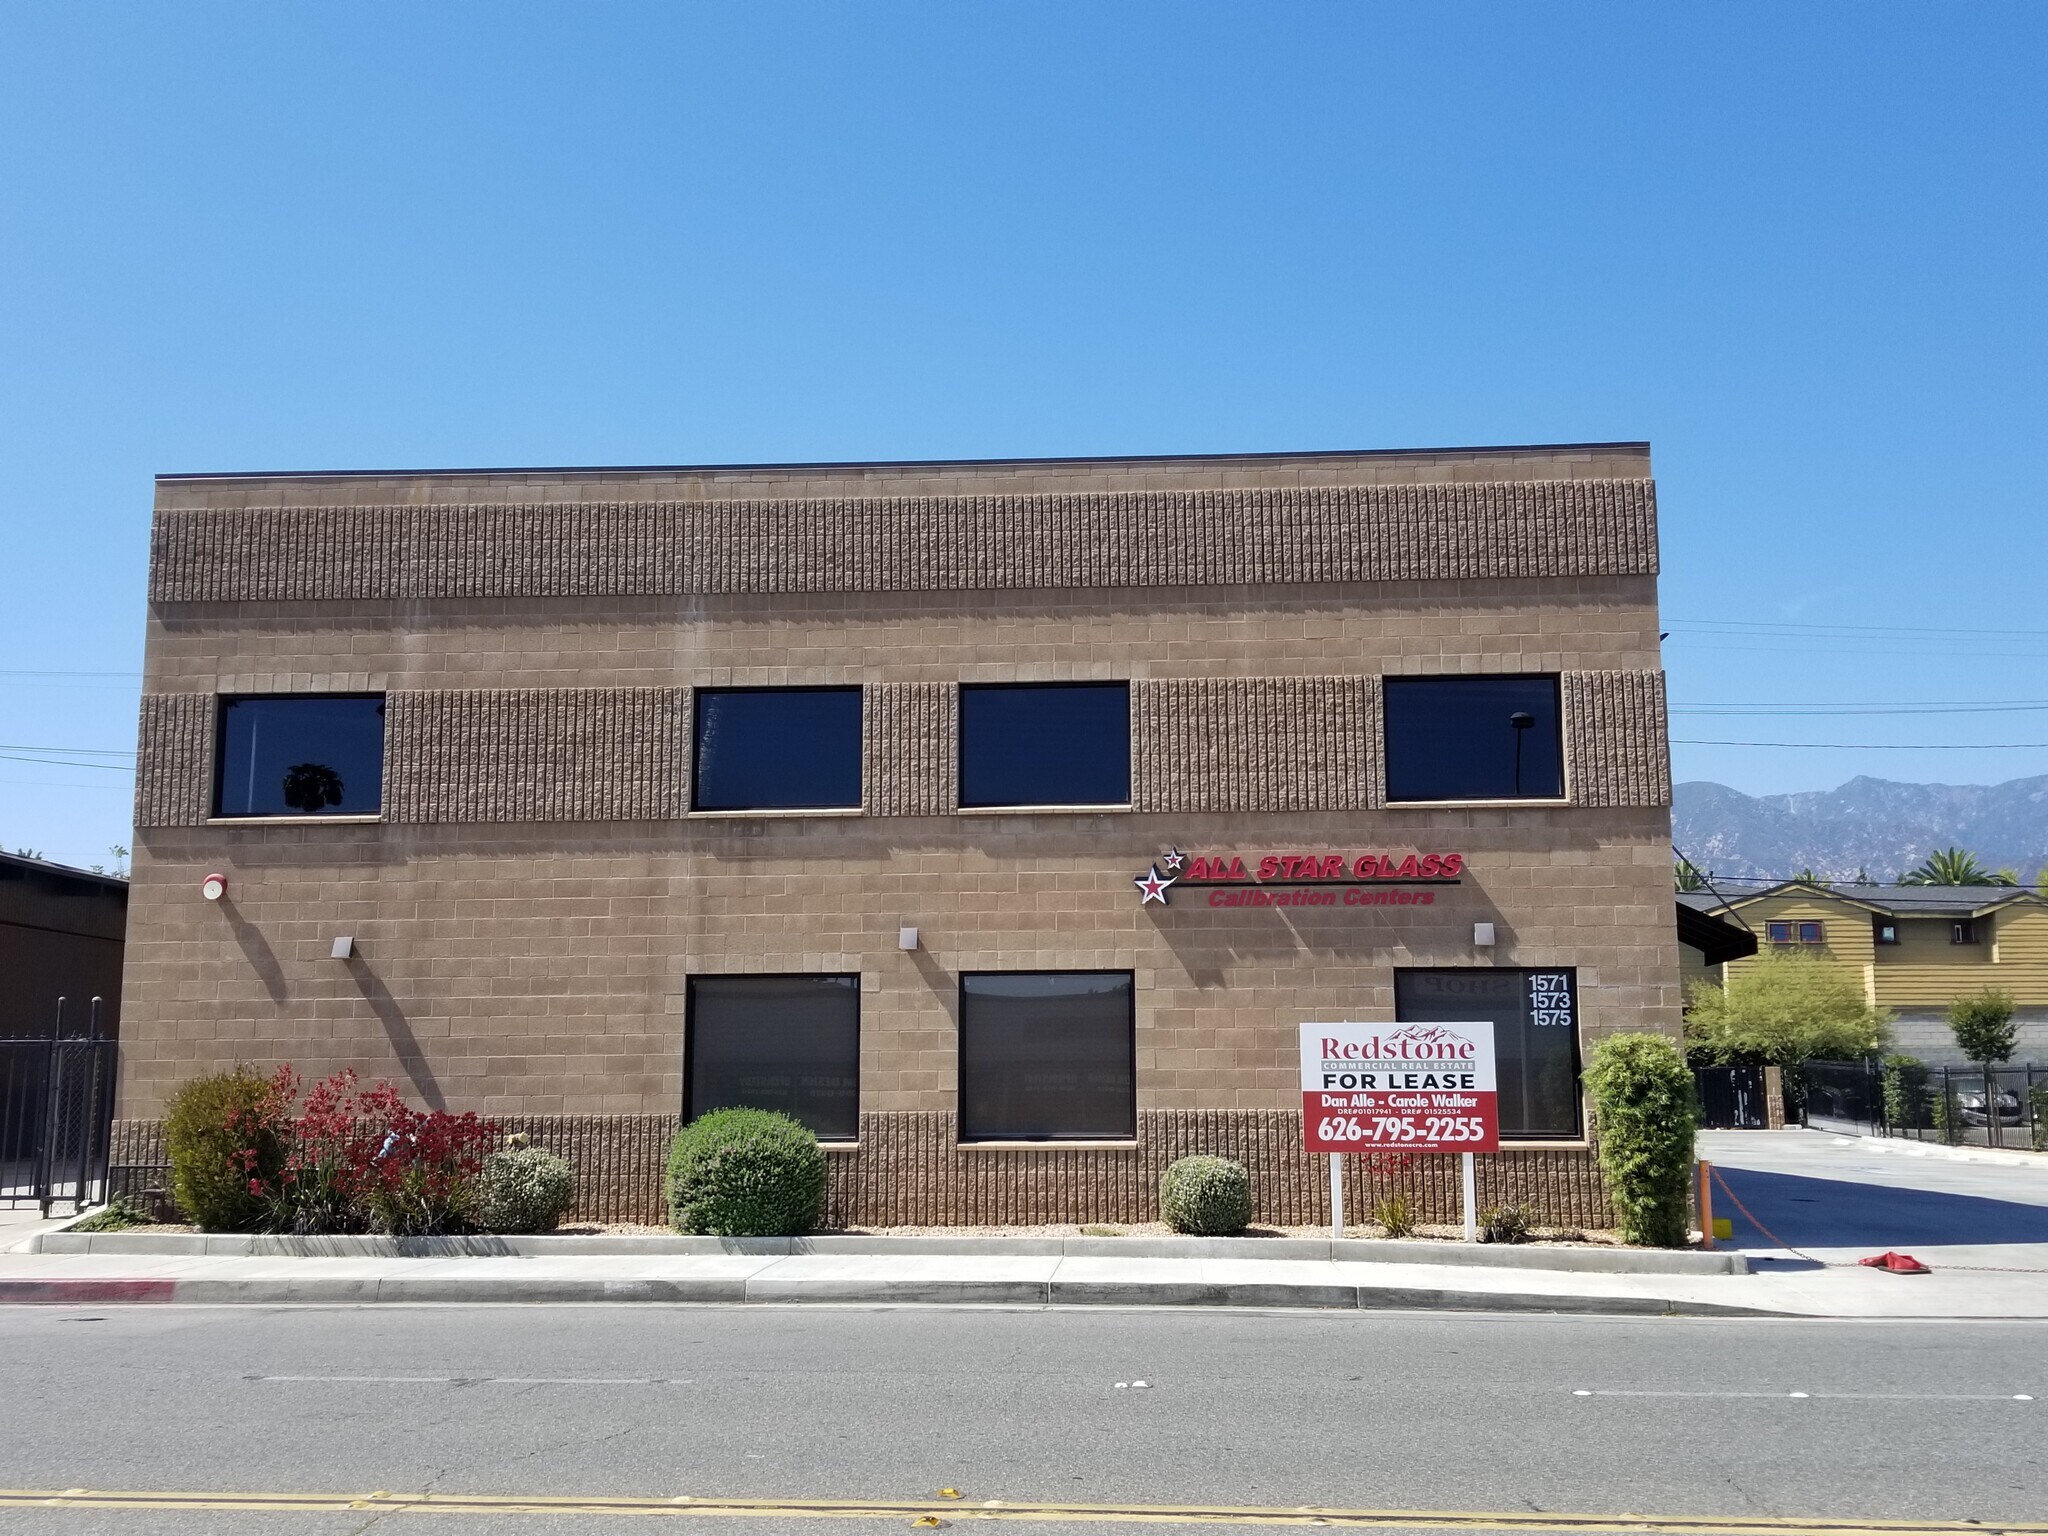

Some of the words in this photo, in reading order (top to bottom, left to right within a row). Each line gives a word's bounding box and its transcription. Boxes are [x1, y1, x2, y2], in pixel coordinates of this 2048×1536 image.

[1183, 856, 1247, 879] ALL
[1256, 855, 1344, 879] STAR
[1352, 853, 1463, 878] GLASS
[1208, 889, 1336, 907] Calibration
[1343, 888, 1435, 906] Centers
[1528, 974, 1567, 991] 1571
[1529, 992, 1571, 1008] 1573
[1530, 1009, 1572, 1026] 1575
[1320, 1036, 1476, 1060] Redstone
[1323, 1061, 1397, 1070] COMMERCIAL
[1401, 1061, 1430, 1070] REAL
[1433, 1061, 1474, 1070] ESTATE
[1323, 1073, 1377, 1089] FOR
[1388, 1073, 1475, 1089] LEASE
[1321, 1094, 1348, 1107] Dan
[1350, 1094, 1375, 1107] Alle
[1387, 1094, 1429, 1107] Carole
[1431, 1094, 1478, 1107] Walker
[1318, 1116, 1485, 1141] 626-795-2255
